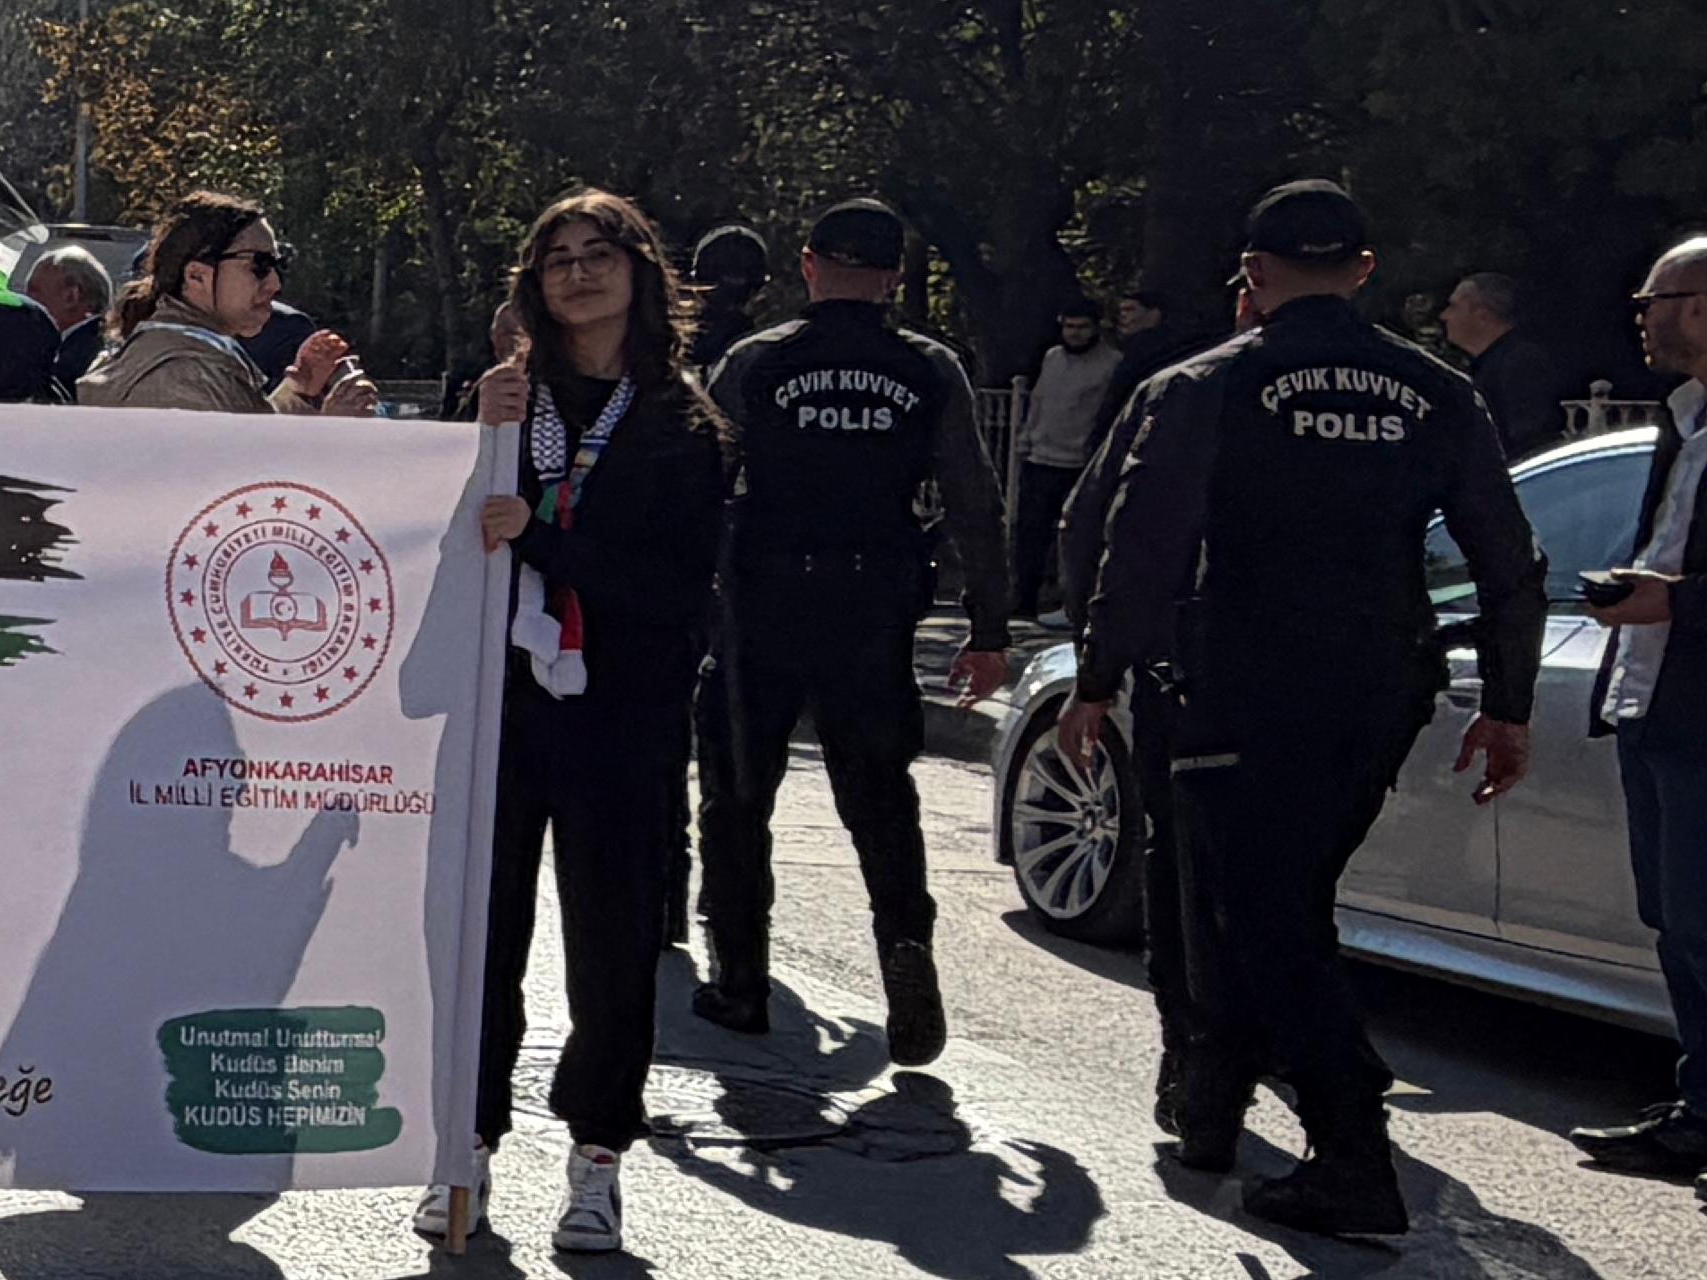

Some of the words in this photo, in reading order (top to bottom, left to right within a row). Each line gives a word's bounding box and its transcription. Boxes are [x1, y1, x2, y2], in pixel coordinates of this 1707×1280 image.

[839, 369, 920, 413] KUVVET
[1334, 367, 1433, 420] KUVVET
[183, 758, 393, 784] AFYONKARAHİSAR
[129, 779, 148, 805] İL
[155, 781, 212, 807] MİLLİ
[220, 782, 298, 811] EĞİTİM
[304, 786, 436, 814] MÜDÜRLÜĞÜ
[210, 1053, 277, 1074] Kudüs
[284, 1055, 345, 1074] Benim
[215, 1079, 283, 1100] Kudüs
[287, 1080, 341, 1101] Senin
[184, 1103, 262, 1126] KUDÜS
